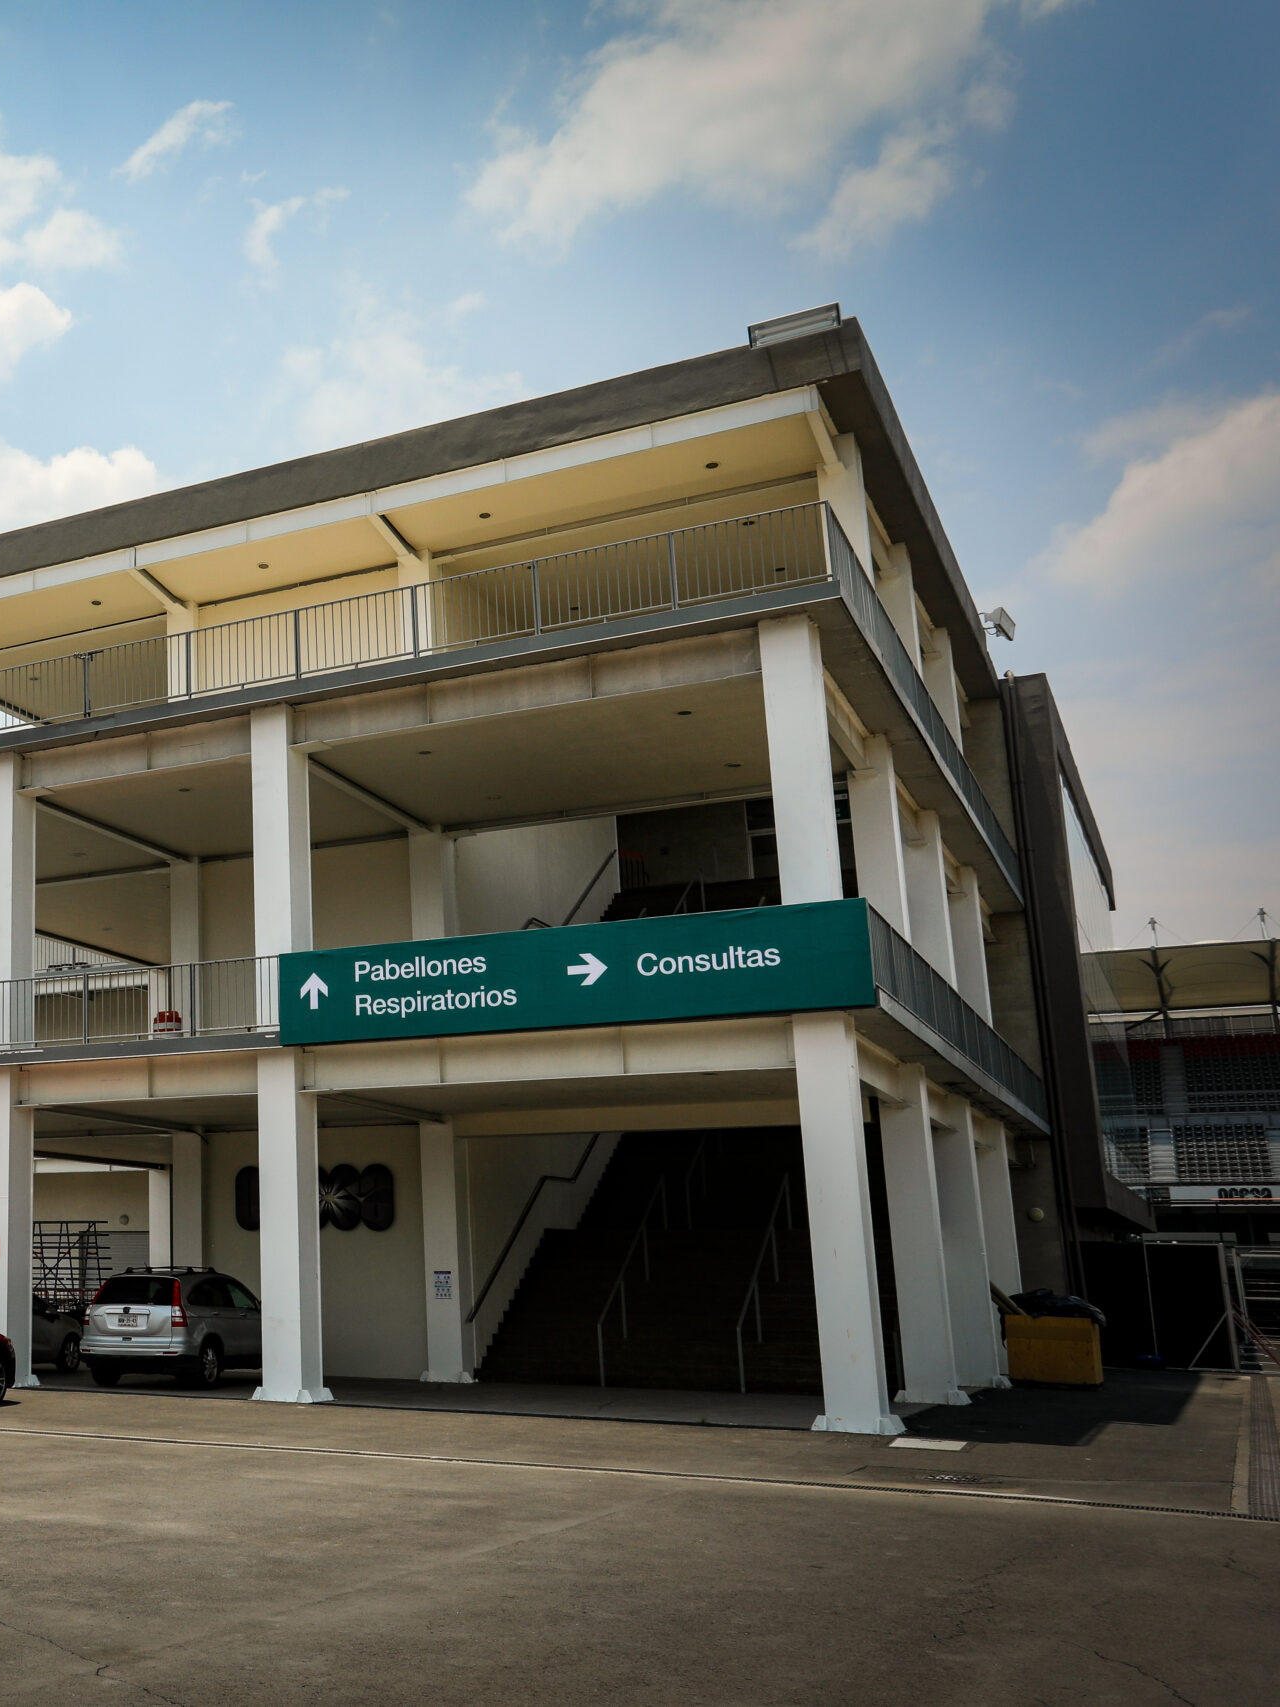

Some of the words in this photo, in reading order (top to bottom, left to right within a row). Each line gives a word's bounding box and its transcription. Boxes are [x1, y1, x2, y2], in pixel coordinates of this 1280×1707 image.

[355, 955, 487, 983] Pabellones
[637, 945, 781, 977] Consultas
[355, 986, 517, 1018] Respiratorios
